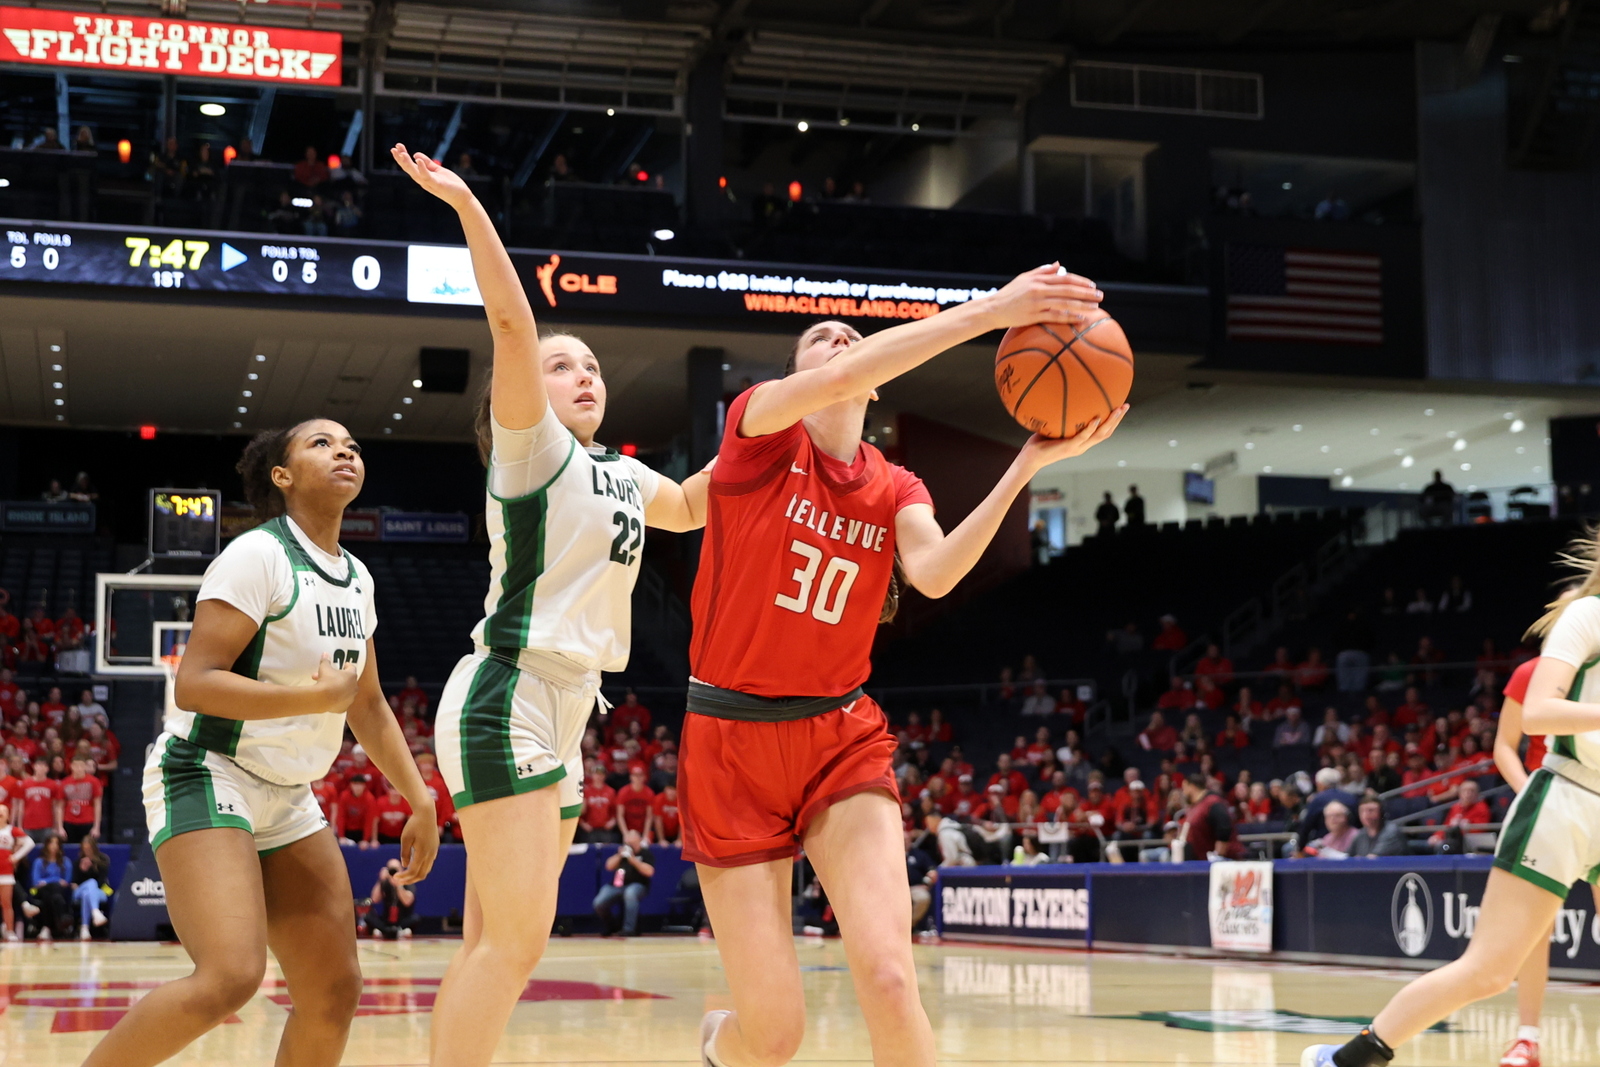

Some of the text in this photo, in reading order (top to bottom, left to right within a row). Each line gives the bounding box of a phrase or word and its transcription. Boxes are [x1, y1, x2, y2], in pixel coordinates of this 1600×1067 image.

[73, 16, 270, 49] THE CONNOR
[30, 28, 311, 79] FLIGHT DECK
[6, 231, 71, 247] TOL FOULS
[10, 246, 59, 270] 5 0
[125, 237, 210, 270] 7:47
[261, 245, 320, 261] FOULS TOL
[152, 271, 184, 288] 1ST
[272, 260, 318, 284] 0 5
[352, 255, 381, 291] 0
[559, 273, 617, 294] CLE
[793, 277, 850, 297] deposit
[868, 283, 936, 300] purchase
[744, 293, 940, 319] WNBACLEVELAND.COM
[170, 495, 213, 516] 7:47
[386, 520, 424, 532] SAINT
[428, 521, 465, 533] LOUIS
[610, 511, 641, 566] 22
[774, 539, 860, 625] 30
[316, 604, 365, 639] LAUREL
[942, 886, 1089, 930] DAYTON FLYERS
